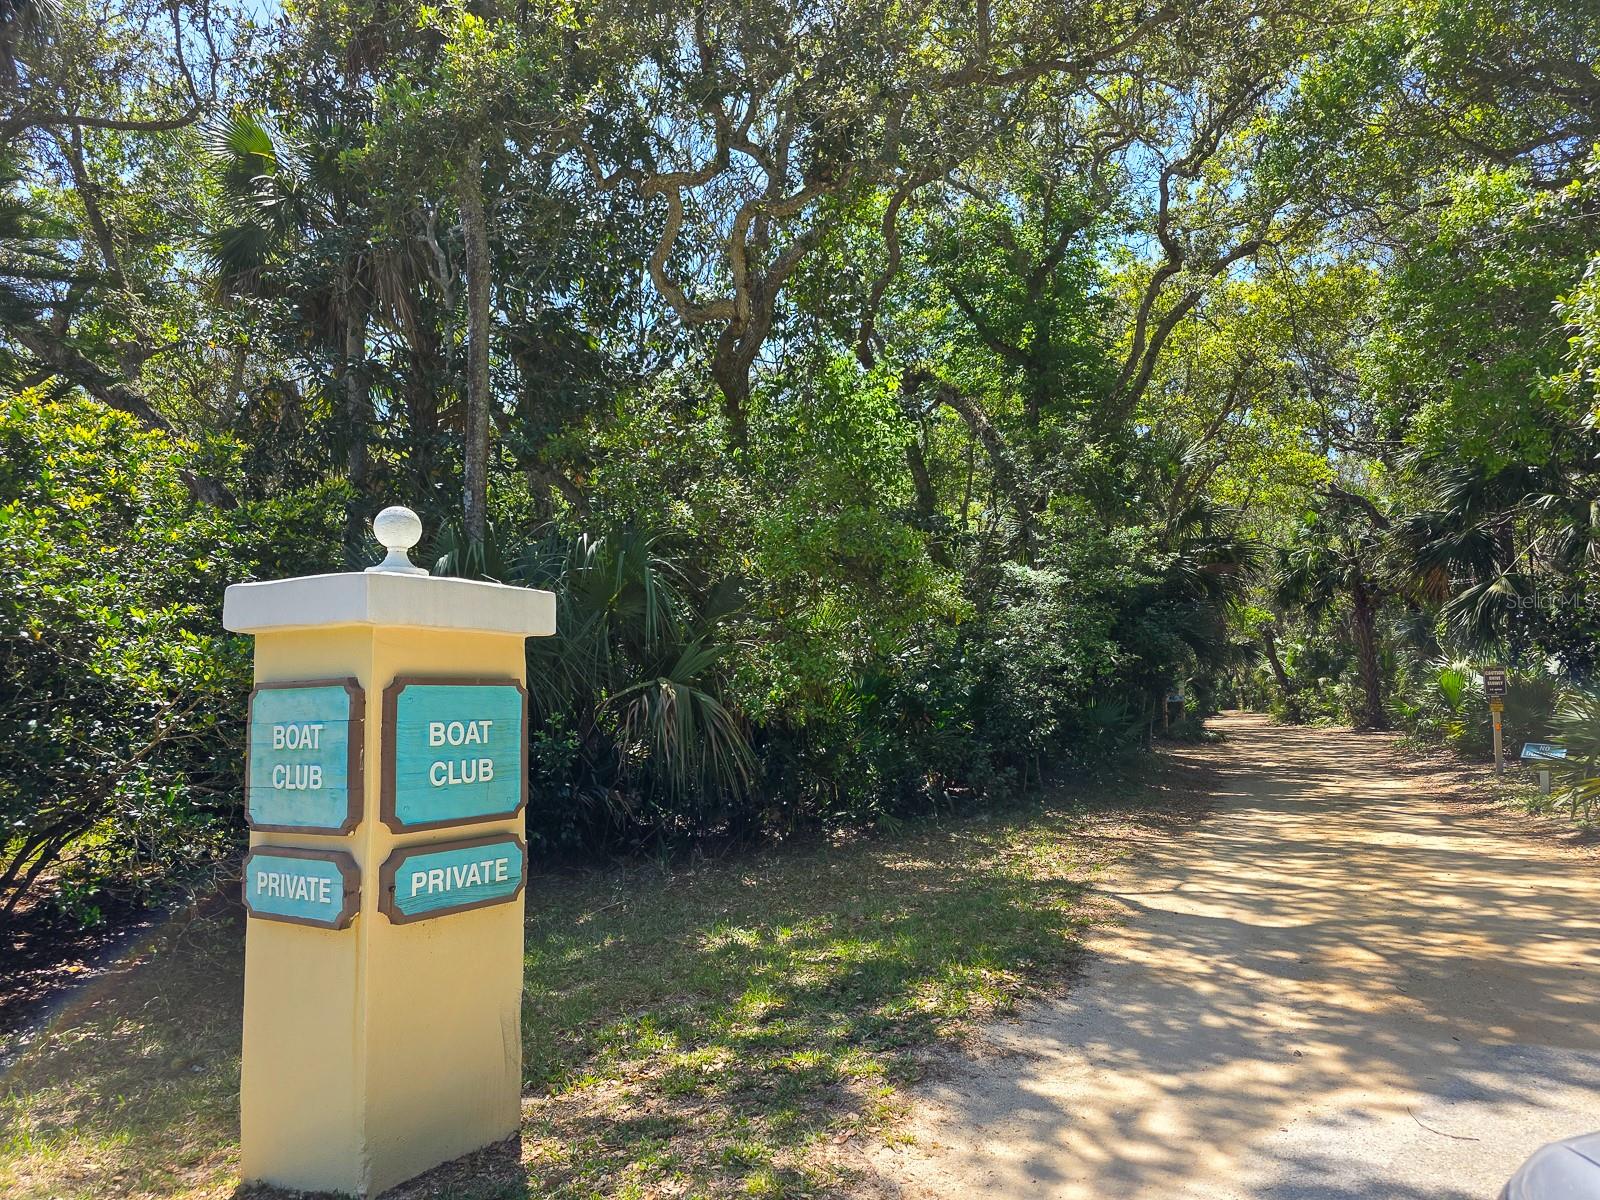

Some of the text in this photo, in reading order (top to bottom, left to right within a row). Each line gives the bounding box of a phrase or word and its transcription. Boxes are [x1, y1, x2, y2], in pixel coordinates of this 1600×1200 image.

[273, 724, 324, 750] BOAT
[429, 720, 493, 747] BOAT
[272, 764, 322, 790] CLUB
[429, 758, 494, 787] CLUB
[256, 872, 332, 904] PRIVATE
[411, 857, 509, 897] PRIVATE
